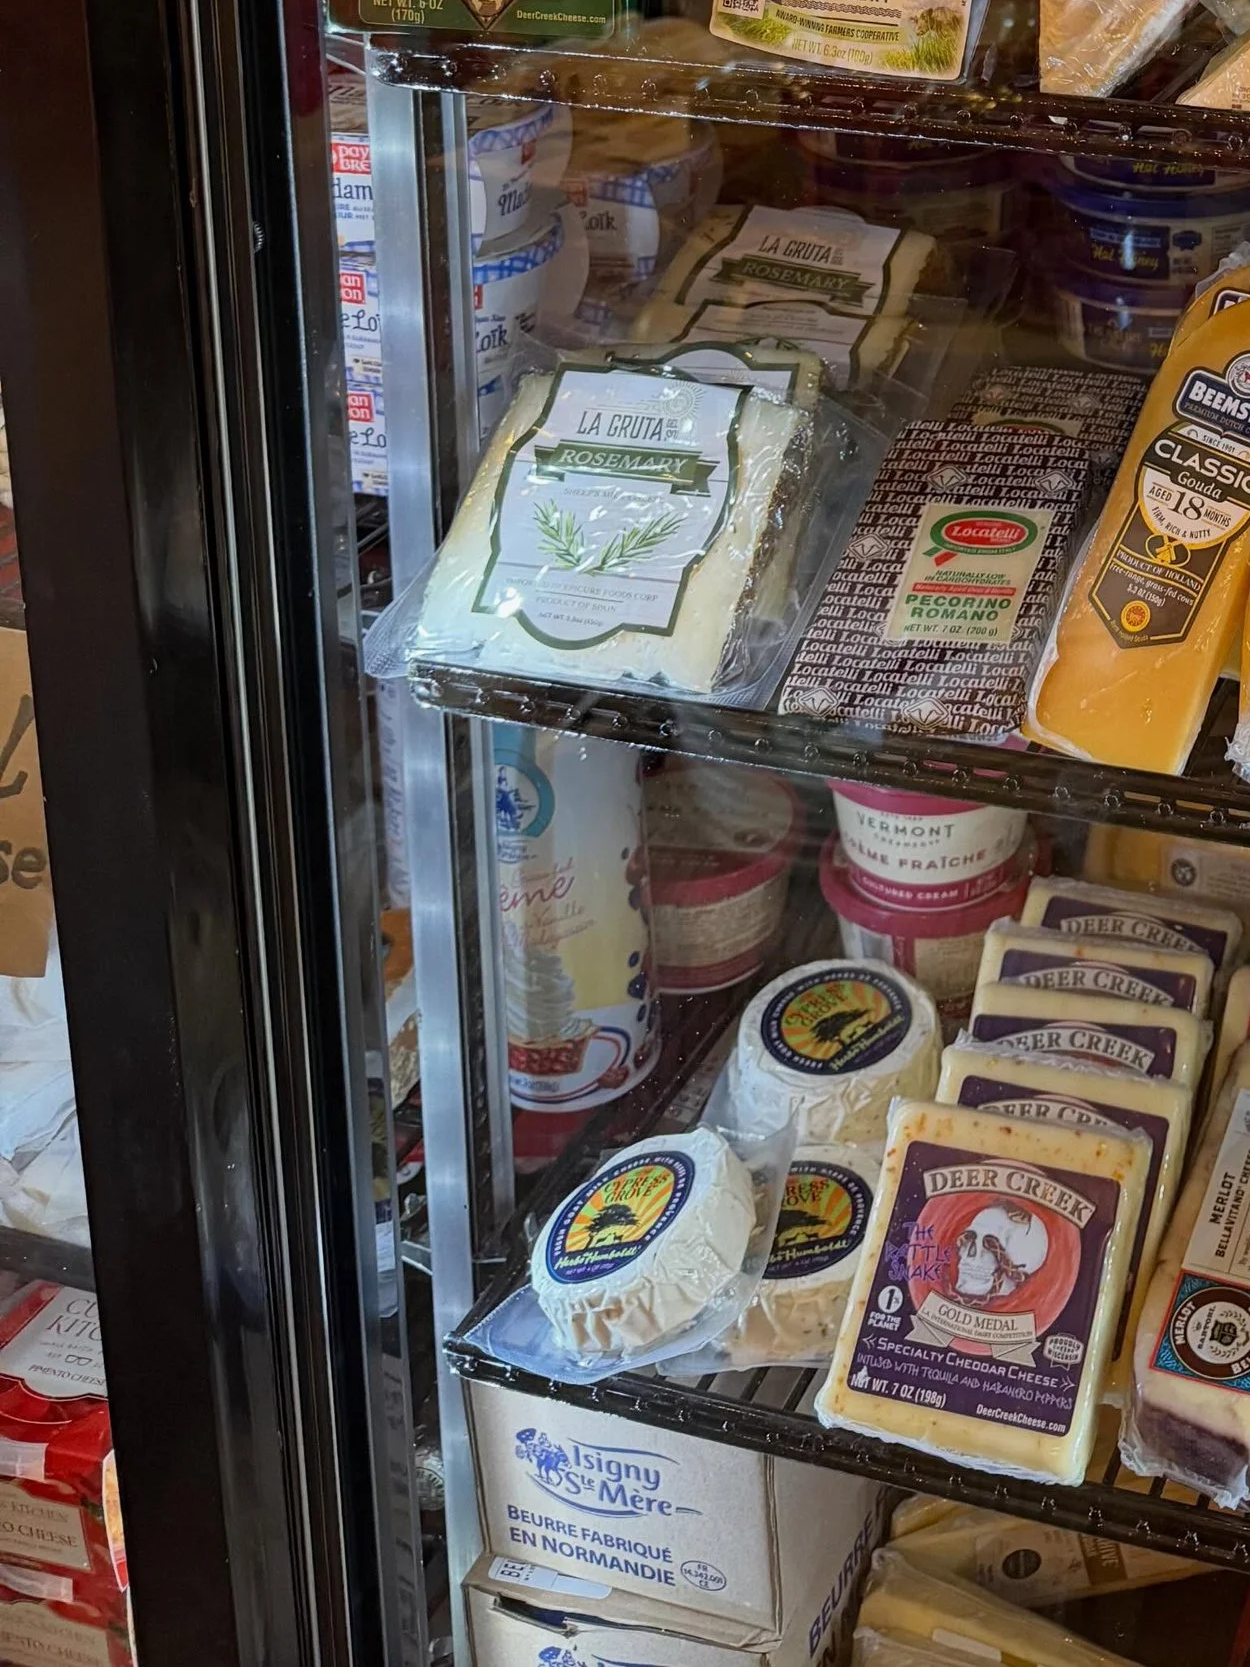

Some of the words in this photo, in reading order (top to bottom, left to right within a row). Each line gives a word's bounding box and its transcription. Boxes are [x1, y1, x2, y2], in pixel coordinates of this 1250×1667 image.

[516, 9, 606, 25] DeerCreekCheese.com
[577, 410, 604, 436] LA
[607, 413, 662, 441] GRUTA
[1202, 434, 1220, 448] SINCE
[558, 448, 689, 475] ROSEMARY
[1177, 471, 1222, 500] Gouda
[1149, 485, 1172, 502] AGED
[1167, 490, 1205, 521] 18
[1203, 508, 1231, 528] MONTHS
[950, 525, 1022, 541] Locatelli
[905, 593, 1012, 610] PECORINO
[910, 606, 999, 621] ROMANO
[856, 811, 956, 838] VERMONT
[928, 1169, 999, 1194] DEER
[1005, 1170, 1094, 1225] CREEK
[1209, 1172, 1236, 1225] MERLOT
[938, 1303, 974, 1324] GOLD
[974, 1314, 1018, 1332] MEDAL
[1174, 1300, 1197, 1346] MERLOT
[876, 1336, 945, 1362] SPECIALTY
[945, 1352, 1006, 1377] CHEDDAR
[1007, 1364, 1060, 1389] CHEESE
[916, 1385, 947, 1409] (198g)
[975, 1403, 1067, 1433] DeerCreekCheese.com
[573, 1445, 660, 1491] Isigny
[598, 1481, 673, 1517] Mère
[507, 1504, 577, 1538] BEURRE
[582, 1527, 673, 1564] FABRIQUÉ
[510, 1526, 537, 1548] EN
[542, 1535, 677, 1587] NORMANDIE
